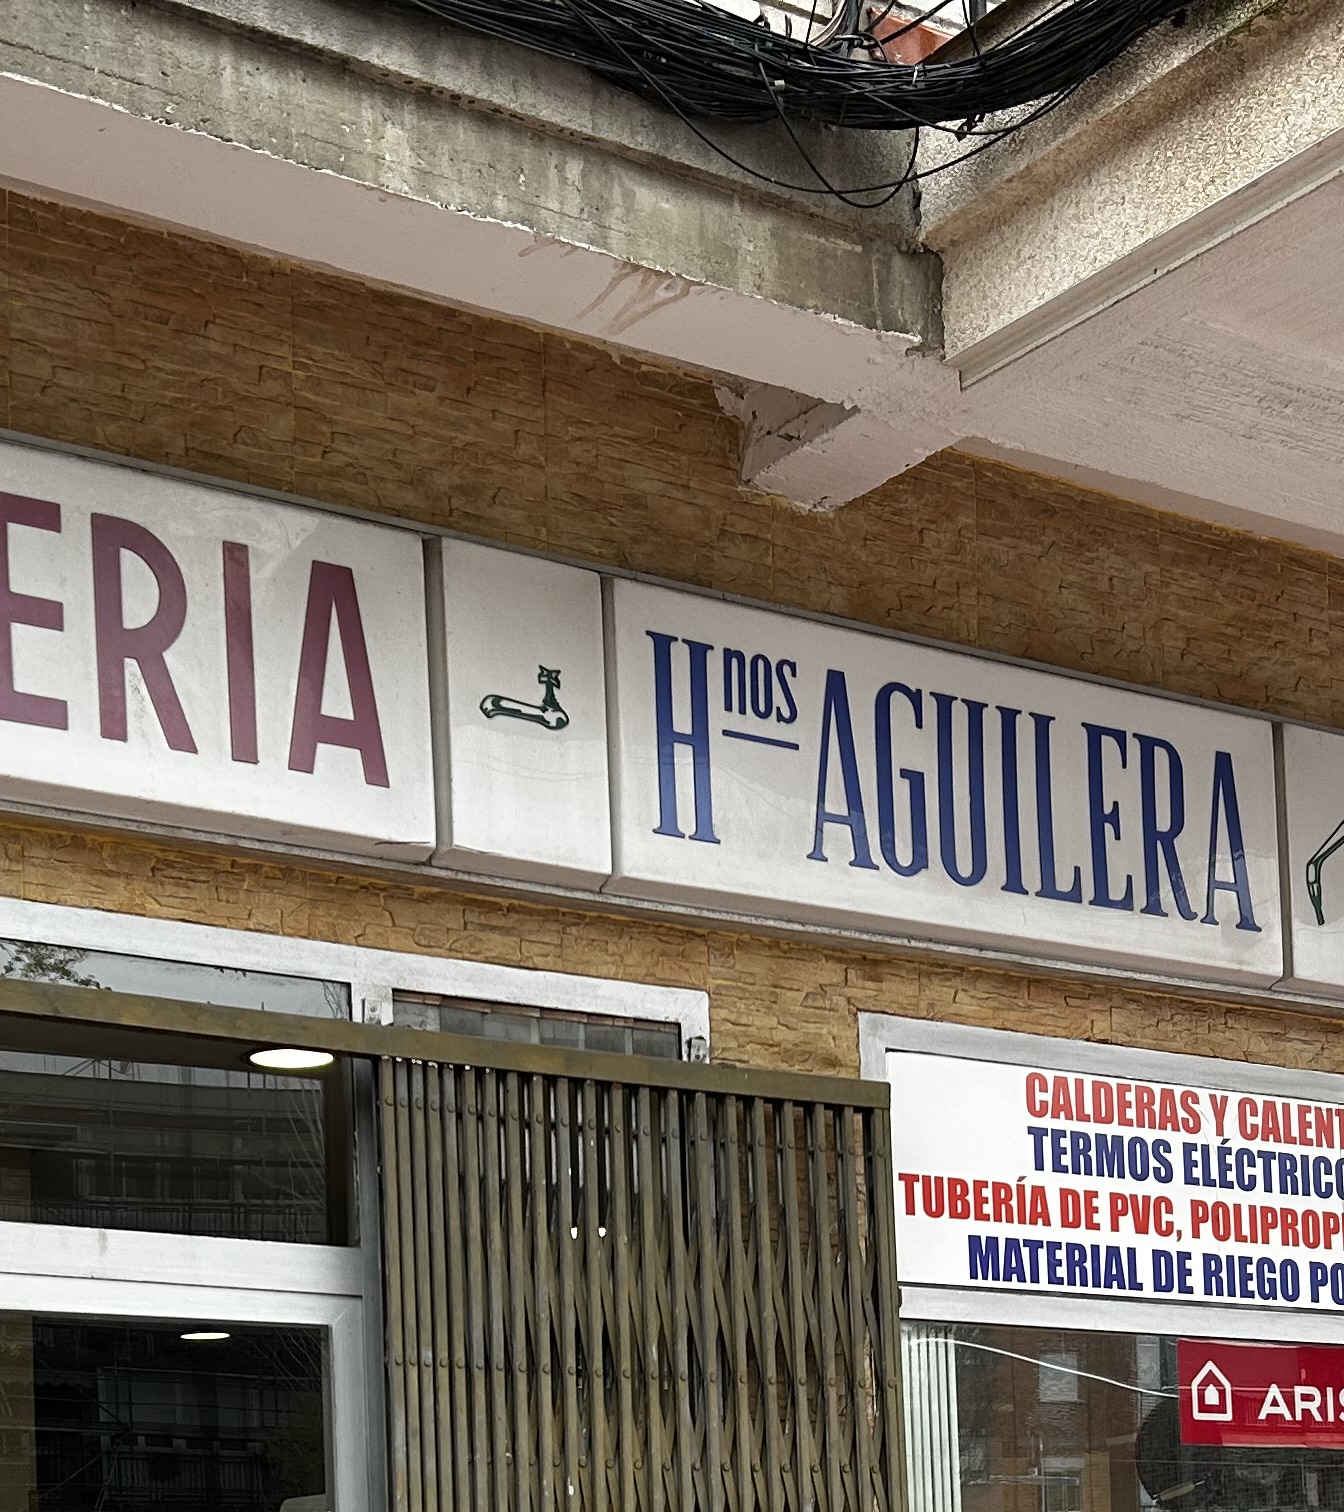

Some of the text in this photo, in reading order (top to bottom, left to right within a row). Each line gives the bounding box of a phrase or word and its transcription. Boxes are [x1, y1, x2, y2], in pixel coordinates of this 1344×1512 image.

[806, 669, 1263, 933] AGUILERA
[1025, 1072, 1202, 1134] CALDERAS
[1208, 1094, 1228, 1137] Y
[1027, 1126, 1174, 1184] TERMOS
[898, 1172, 1052, 1227] TUBERÍA
[1059, 1187, 1102, 1231] DE
[1109, 1192, 1183, 1243] PVC,
[967, 1234, 1144, 1292] MATERIAL
[1151, 1249, 1194, 1295] DE
[1202, 1252, 1301, 1303] RIEGO
